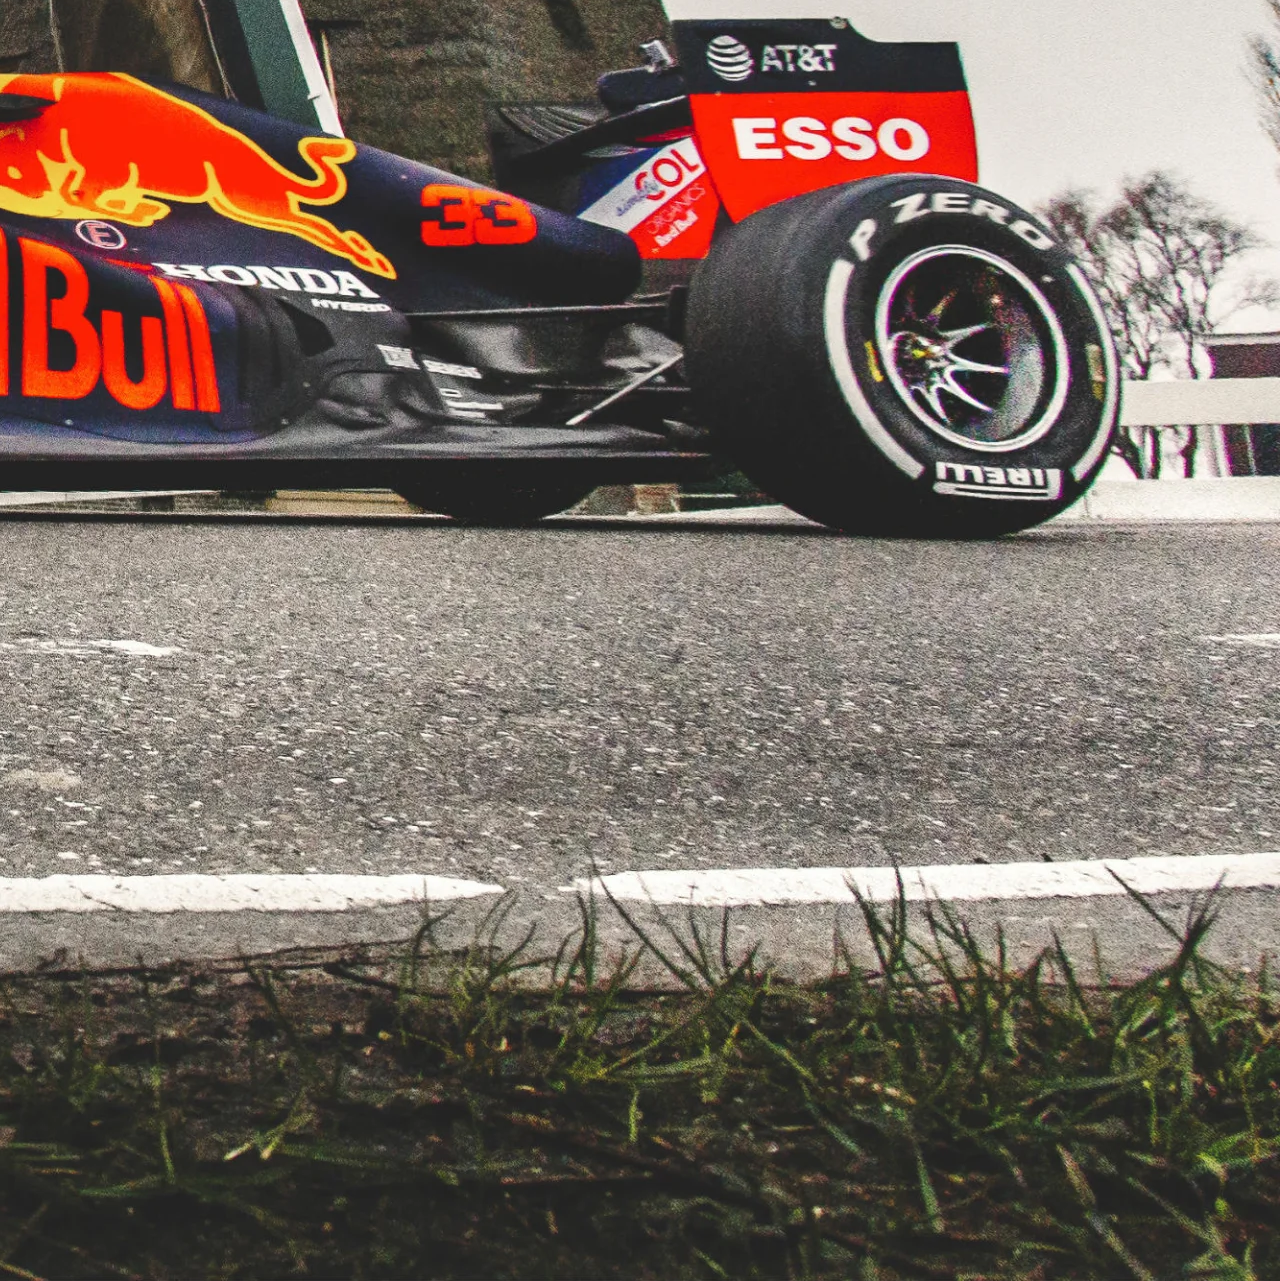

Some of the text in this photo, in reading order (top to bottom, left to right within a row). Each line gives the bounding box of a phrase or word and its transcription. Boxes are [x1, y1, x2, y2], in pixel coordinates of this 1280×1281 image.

[761, 44, 837, 71] AT&T
[732, 116, 930, 161] ESSO
[421, 183, 538, 246] 33
[849, 192, 1056, 261] P ZERO
[151, 262, 381, 298] HONDA
[933, 461, 1063, 500] PIRELLI
